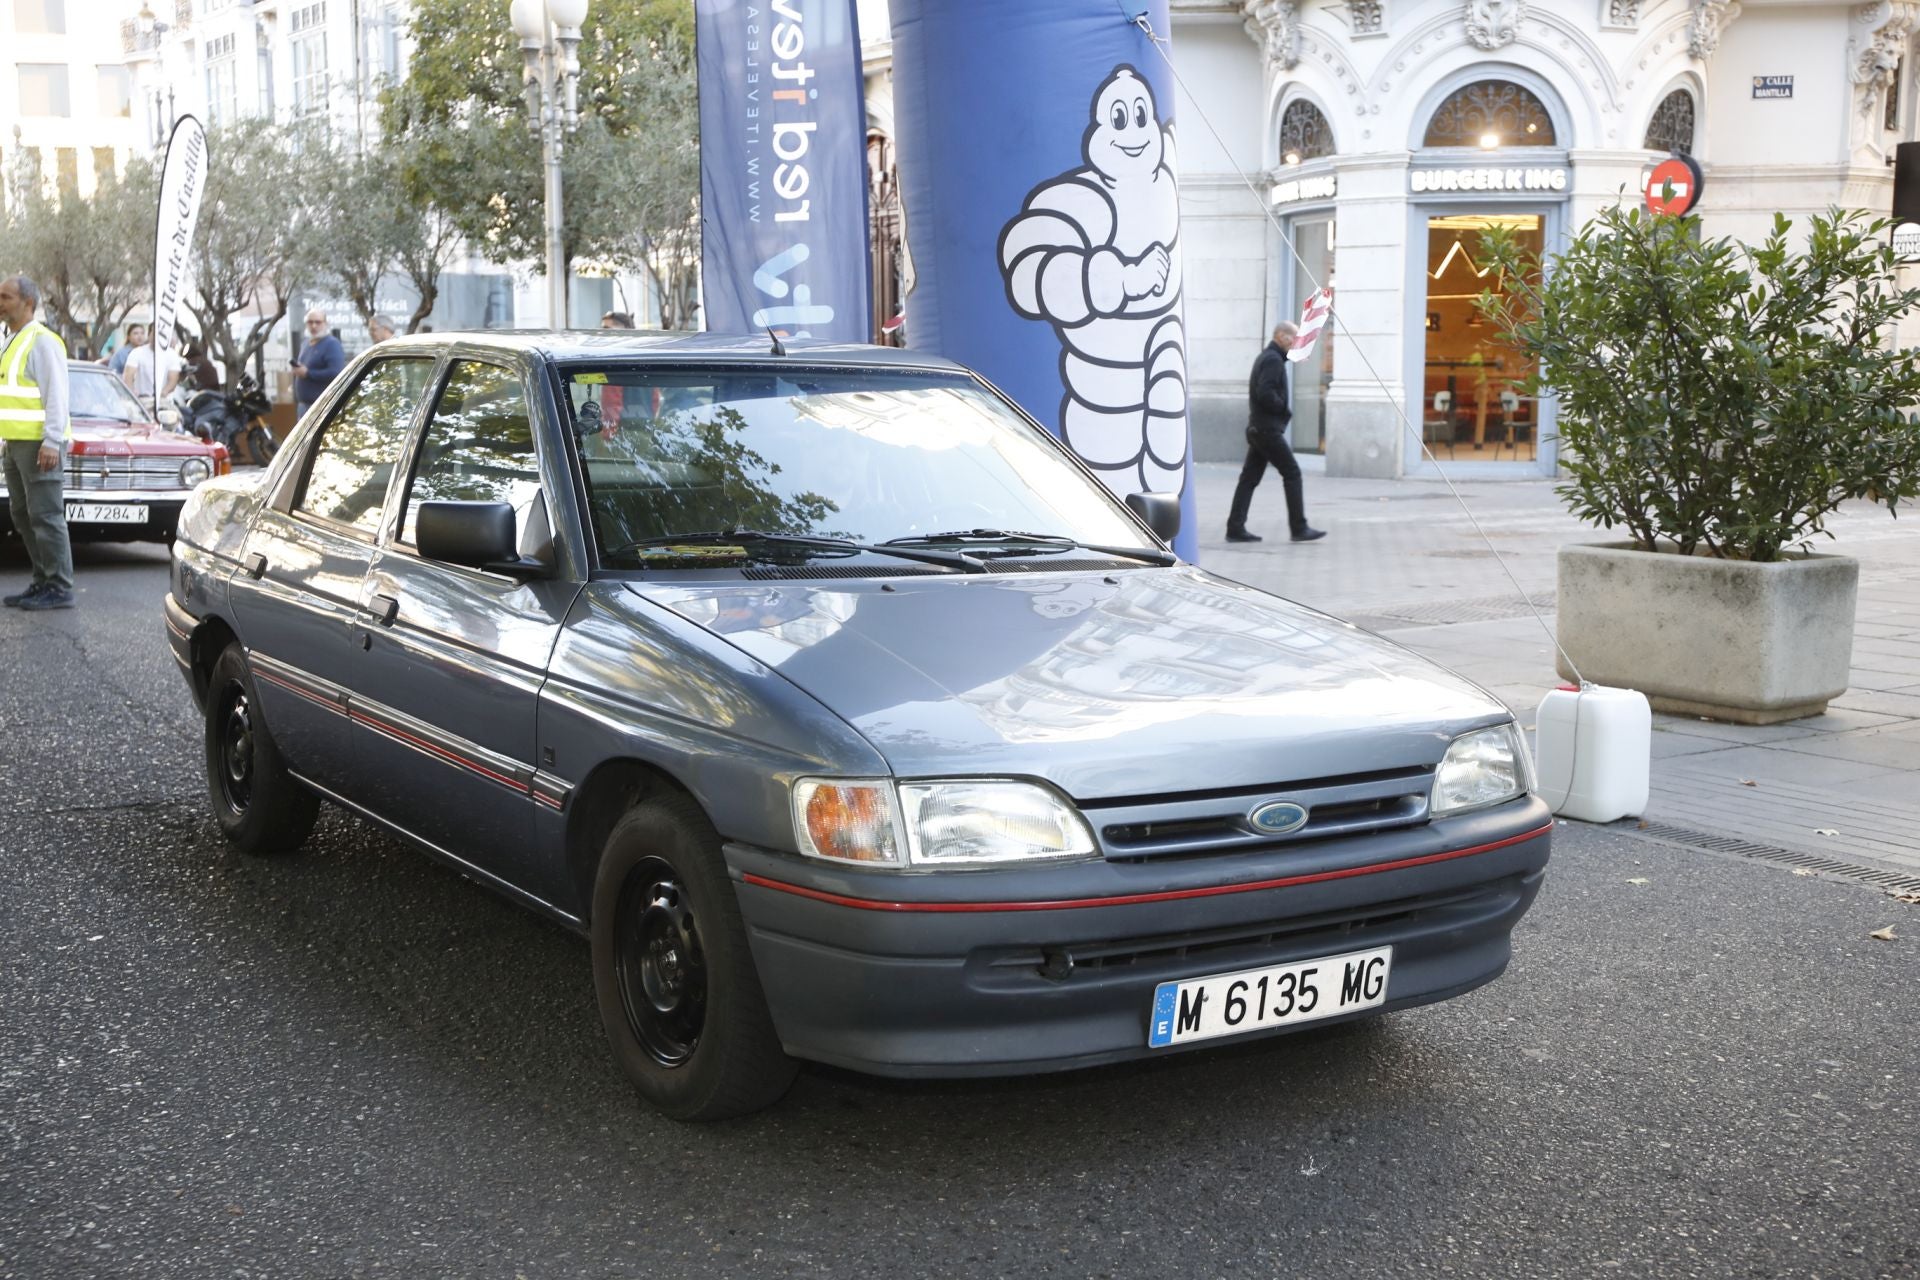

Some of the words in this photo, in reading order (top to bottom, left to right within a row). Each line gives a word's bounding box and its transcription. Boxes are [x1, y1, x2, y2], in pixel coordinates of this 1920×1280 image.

[1755, 87, 1791, 98] MANTILLA
[1766, 76, 1793, 86] CALLE
[177, 129, 203, 220] Castilla
[1411, 169, 1503, 191] BURGER
[1505, 168, 1567, 190] KING
[172, 220, 189, 247] de
[160, 250, 183, 314] Norte
[67, 505, 86, 520] VA
[94, 505, 130, 521] 7284
[138, 506, 147, 522] K
[1176, 986, 1205, 1035] M
[1224, 968, 1319, 1026] 6135
[1339, 957, 1386, 1007] MG
[1157, 1020, 1168, 1035] E
